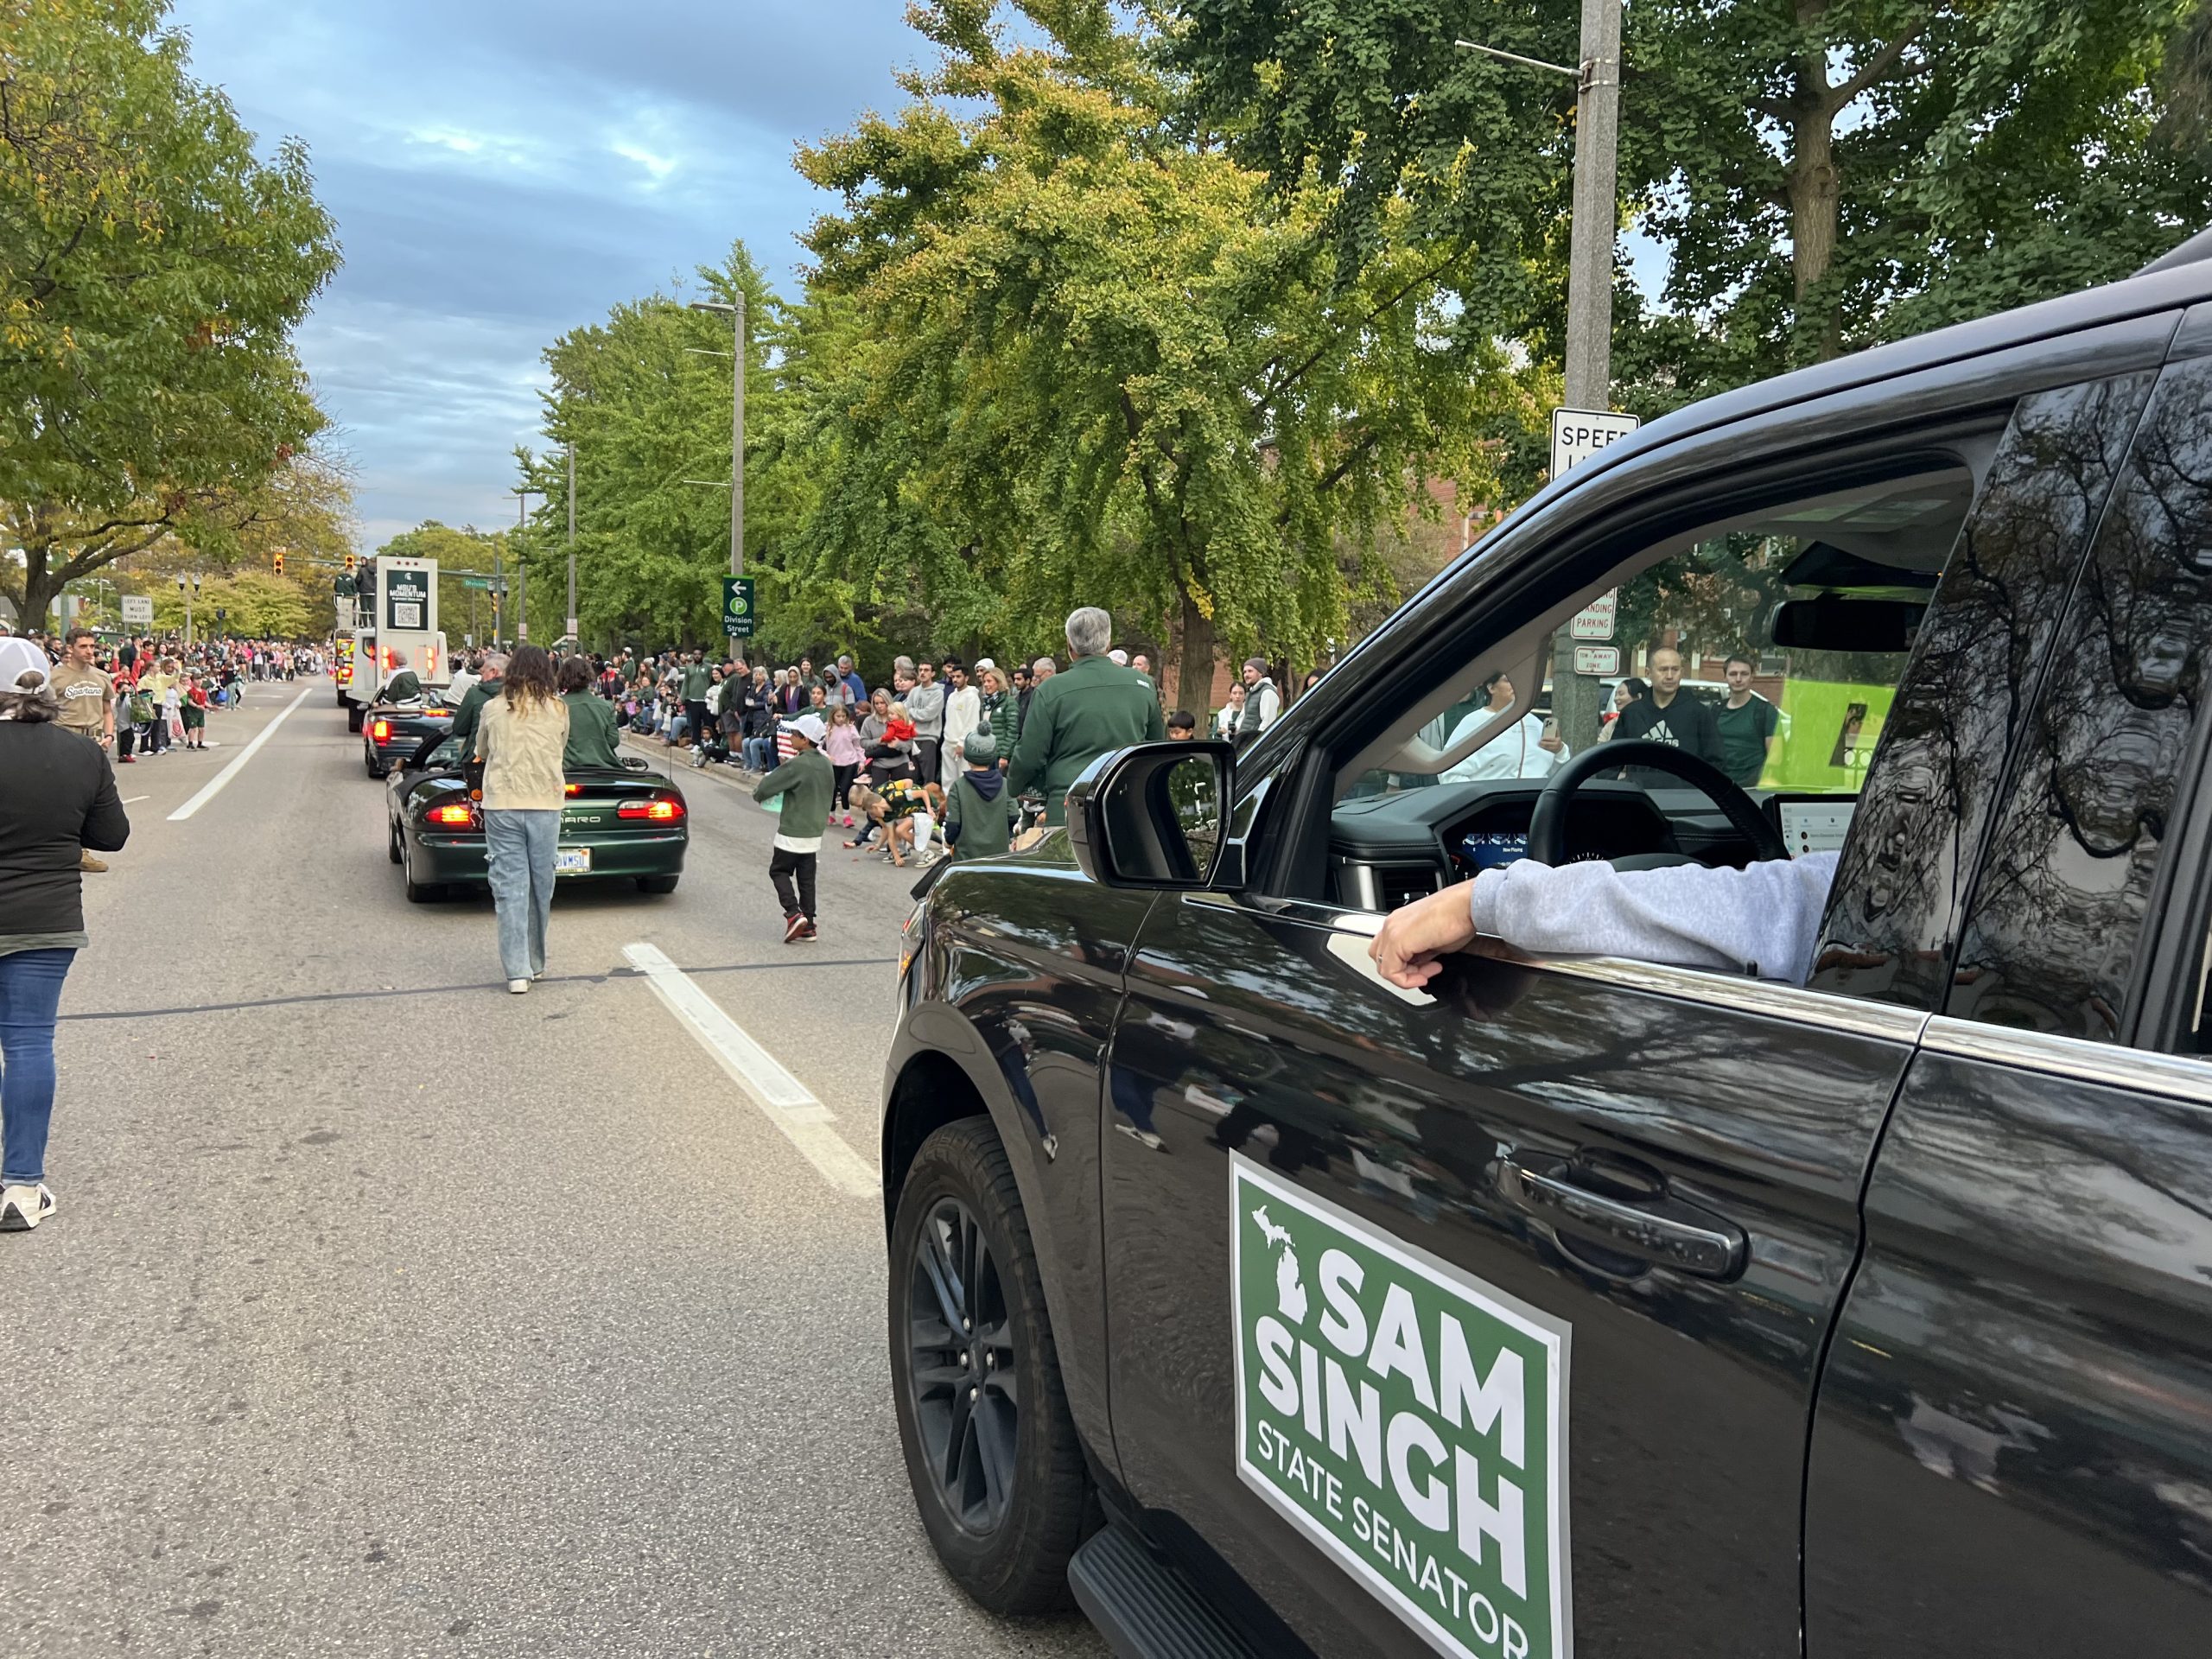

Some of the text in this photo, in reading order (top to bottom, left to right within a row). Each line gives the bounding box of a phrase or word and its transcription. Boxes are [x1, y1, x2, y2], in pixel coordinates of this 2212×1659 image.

[1561, 426, 1629, 448] SPEE
[1583, 604, 1612, 613] ANDING
[724, 615, 753, 624] Division
[1577, 618, 1609, 628] PARKING
[66, 686, 102, 699] Spartans
[1319, 1249, 1524, 1470] SAM
[1255, 1315, 1527, 1601] SINGH
[1257, 1420, 1529, 1659] STATE SENATOR
